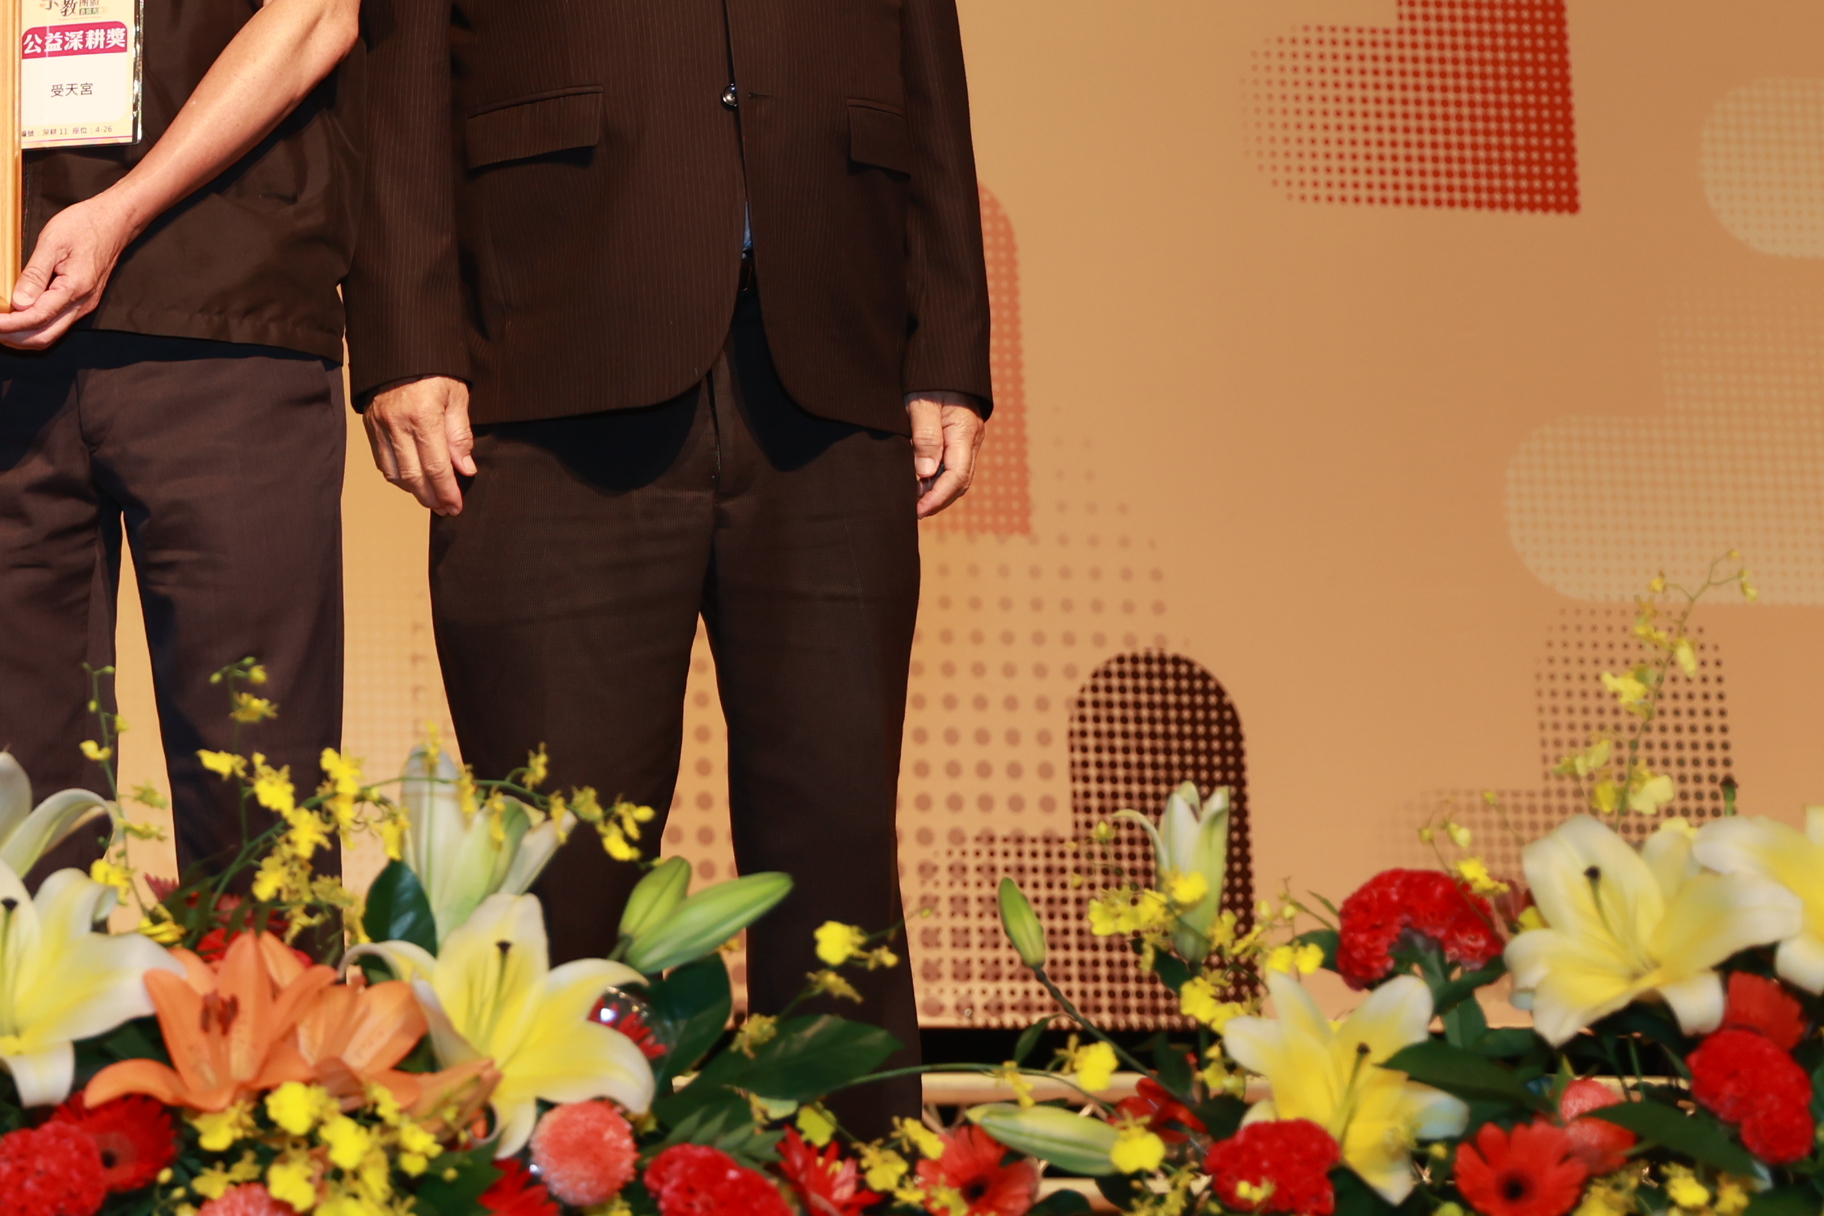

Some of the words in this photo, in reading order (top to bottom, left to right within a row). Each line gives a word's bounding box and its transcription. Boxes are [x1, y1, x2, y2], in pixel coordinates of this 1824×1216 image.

[23, 27, 126, 54] 公益深耕獎
[51, 82, 94, 98] 受天宮
